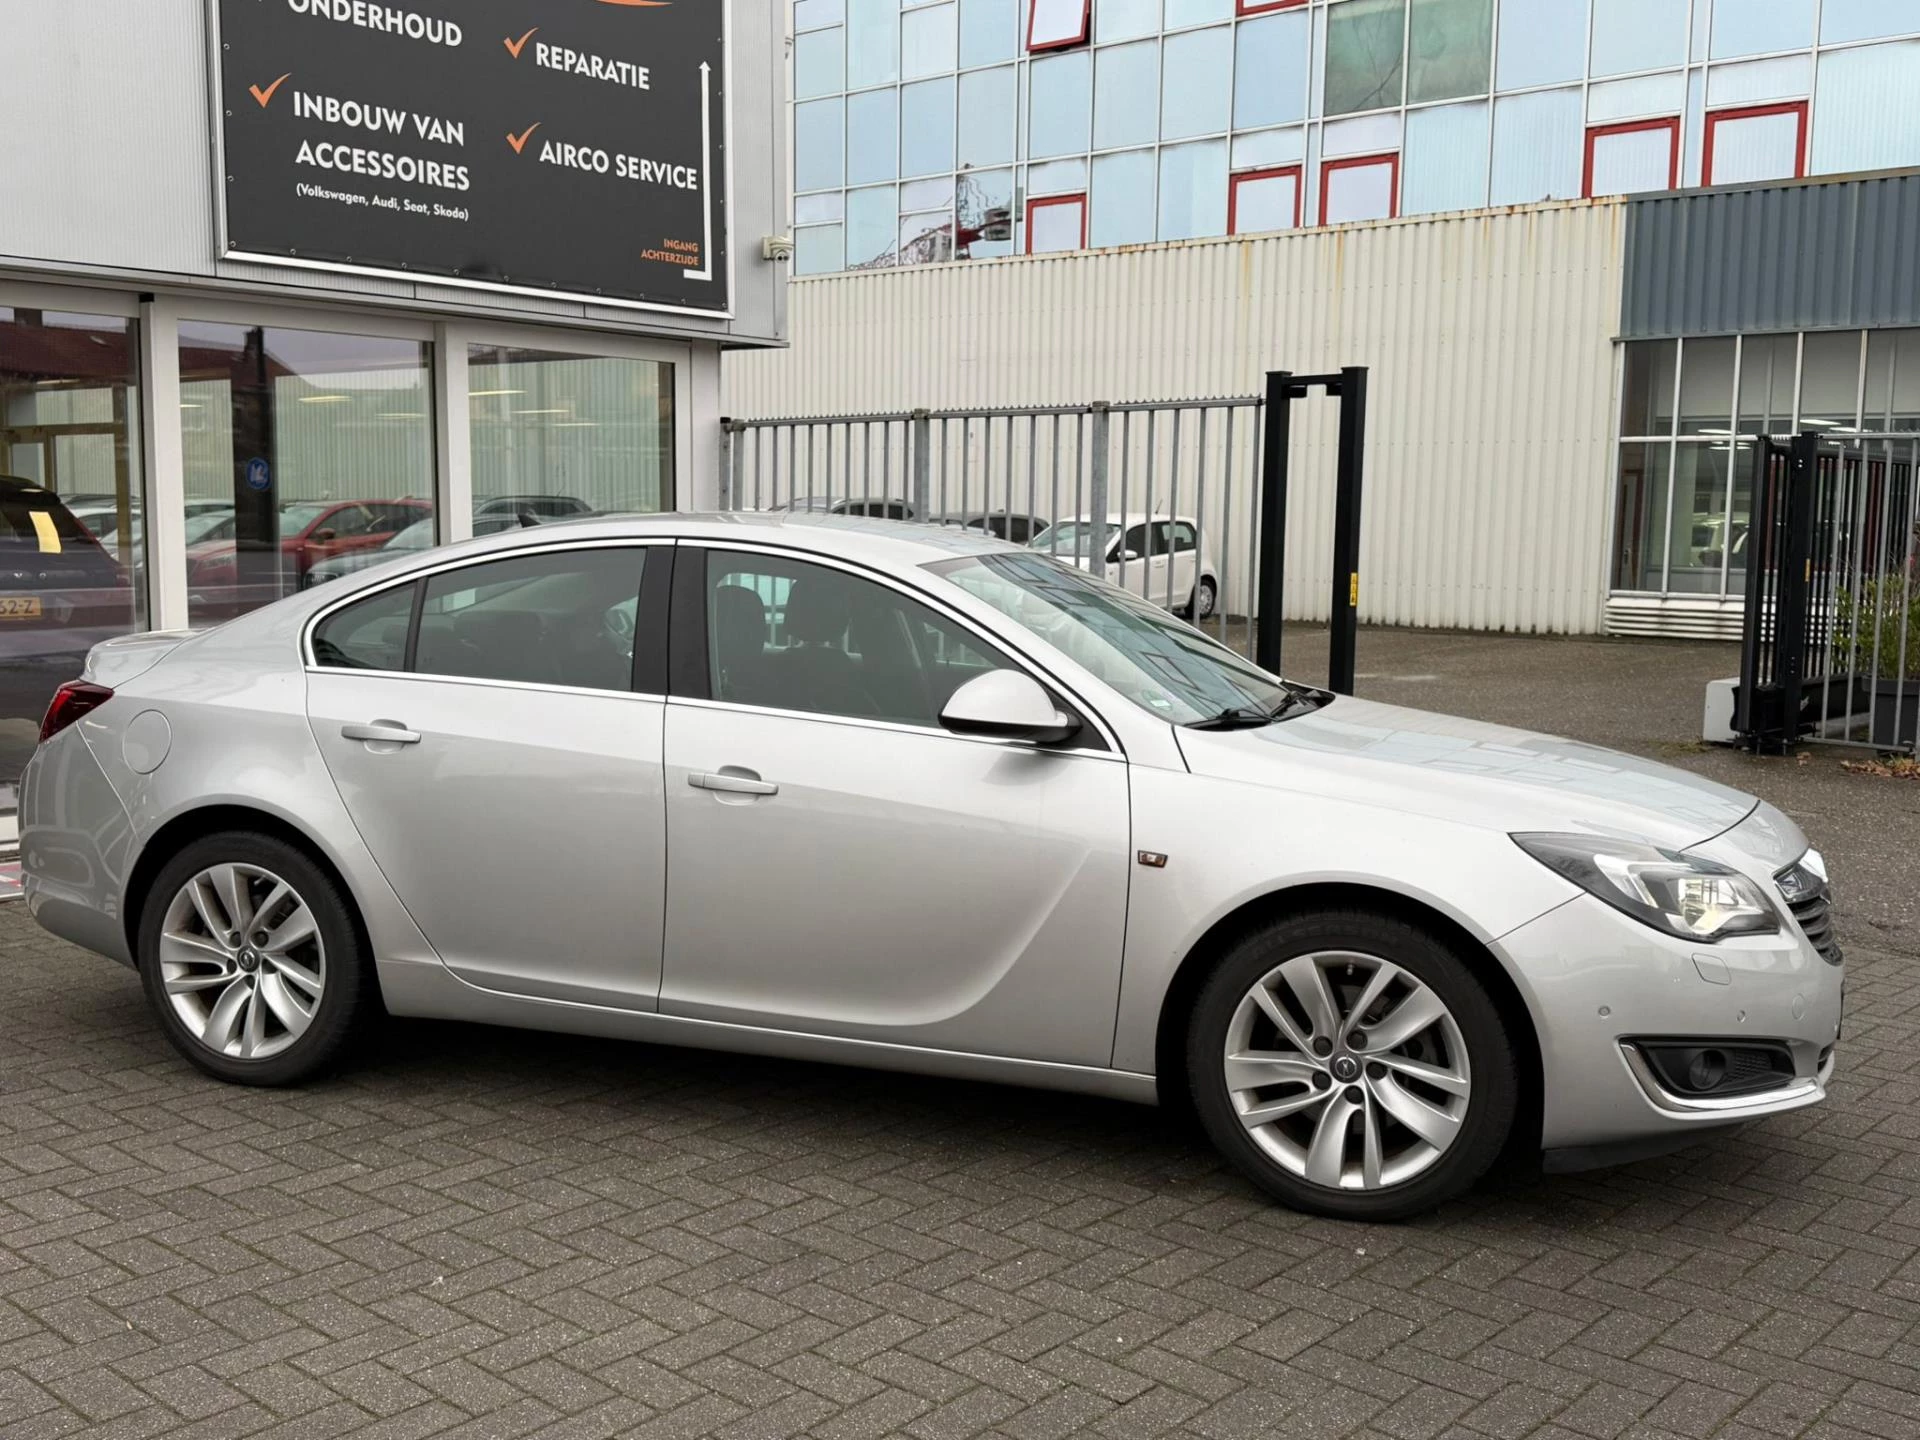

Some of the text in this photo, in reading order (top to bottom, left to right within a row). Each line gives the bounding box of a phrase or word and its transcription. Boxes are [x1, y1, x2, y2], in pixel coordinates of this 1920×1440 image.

[536, 42, 650, 90] REPARATIE
[294, 91, 464, 146] INBOUW VAN
[295, 139, 470, 191] ACCESSOIRES
[539, 140, 697, 190] AIRCO SERVICE
[296, 183, 469, 221] (Volkswagen, Audi, Seat, Skoda)
[641, 248, 699, 266] ACHTERZIJDE
[664, 238, 698, 252] INGANG
